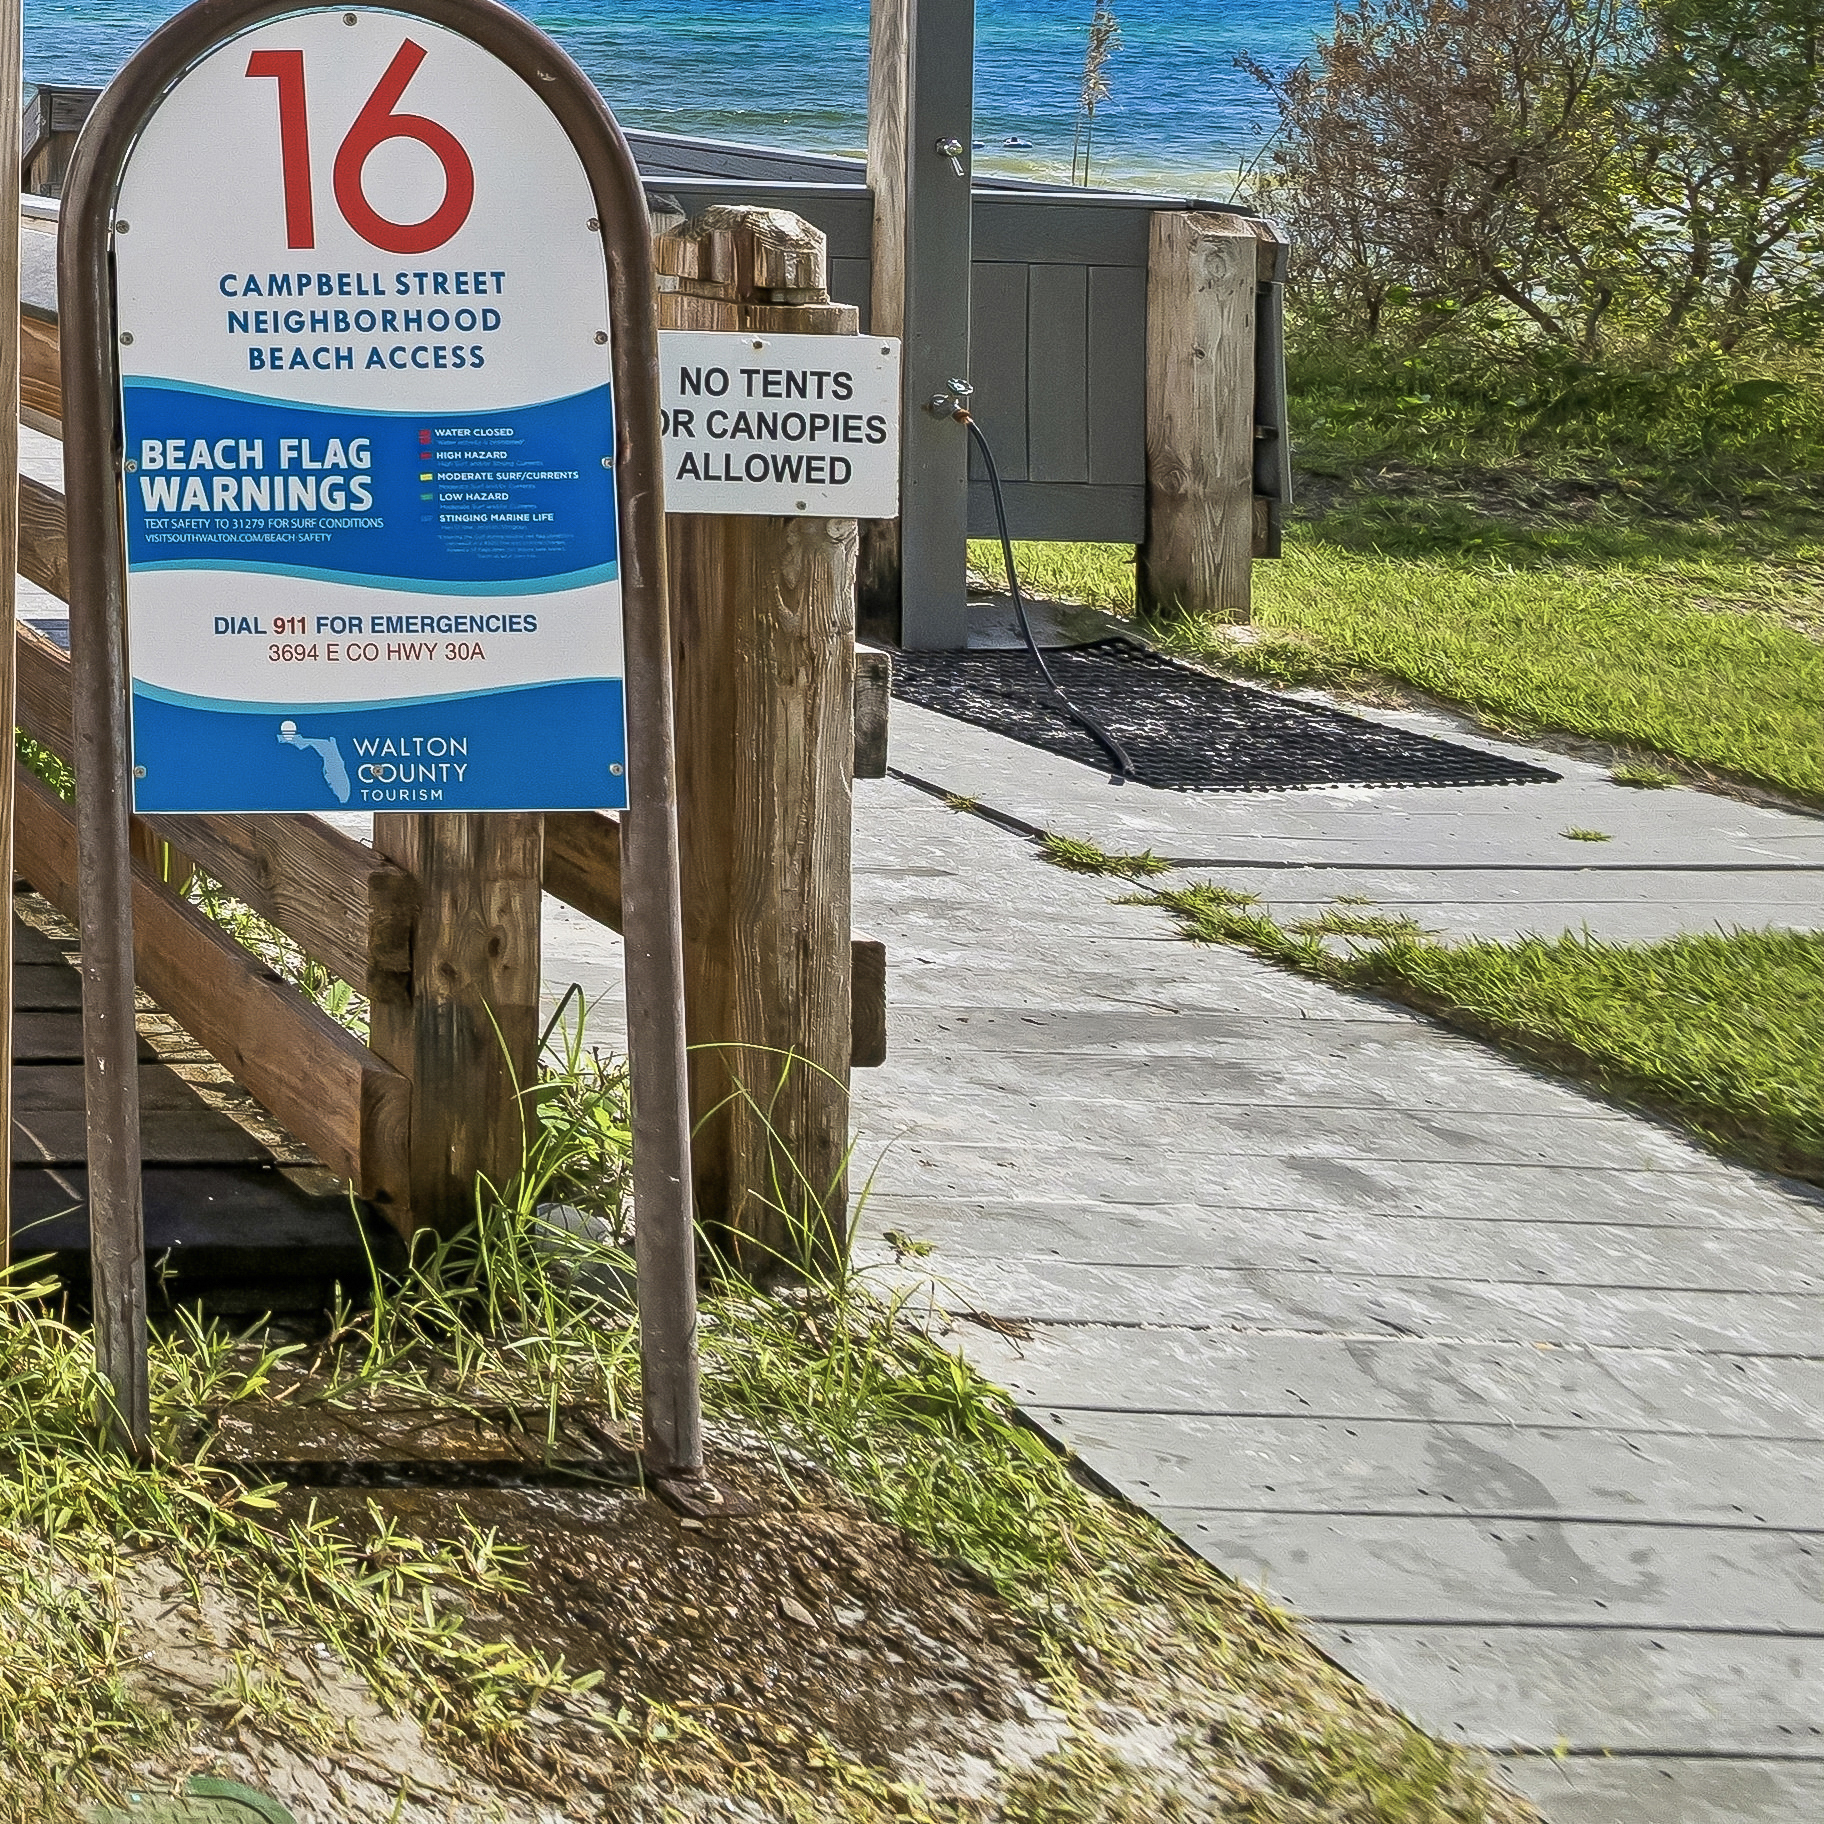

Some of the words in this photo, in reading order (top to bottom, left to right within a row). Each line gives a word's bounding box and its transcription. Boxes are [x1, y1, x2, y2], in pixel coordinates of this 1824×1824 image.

[244, 37, 475, 254] 16
[219, 272, 386, 297] CAMPBELL
[395, 271, 506, 296] STREET
[227, 308, 502, 334] NEIGHBORHOOD
[248, 346, 354, 370] BEACH
[364, 345, 486, 370] ACCESS
[680, 366, 730, 397] NO
[740, 368, 853, 401] TENTS
[434, 428, 471, 437] WATER
[473, 428, 514, 437] CLOSED
[706, 409, 887, 444] CANOPIES
[141, 438, 264, 470] BEACH
[279, 438, 372, 470] FLAG
[436, 451, 462, 460] HIGH
[464, 451, 508, 460] HAZARD
[437, 472, 494, 481] MODERATE
[496, 471, 580, 480] SURF/CURRENTS
[675, 451, 852, 485] ALLOWED
[139, 475, 373, 512] WARNINGS
[439, 492, 464, 501] LOW
[465, 492, 509, 501] HAZARD
[144, 518, 170, 529] TEXT
[171, 518, 211, 529] SAFETY
[214, 518, 229, 529] TO
[232, 518, 265, 529] 31279
[268, 518, 290, 529] FOR
[291, 518, 317, 528] SURF
[319, 517, 384, 529] CONDITIONS
[439, 514, 488, 523] STINGING
[490, 513, 530, 522] MARINE
[532, 512, 555, 522] LIFE
[214, 616, 267, 634] DIAL
[273, 616, 307, 634] 911
[316, 616, 363, 634] FOR
[370, 614, 538, 633] EMERGENCIES
[268, 643, 319, 662] 3694
[327, 643, 340, 661] E
[346, 642, 379, 661] CO
[387, 642, 438, 661] HWY
[444, 642, 486, 661] 30A
[353, 737, 468, 757] WALTON
[358, 763, 469, 783] COUNTY
[361, 789, 443, 801] TOURISM
